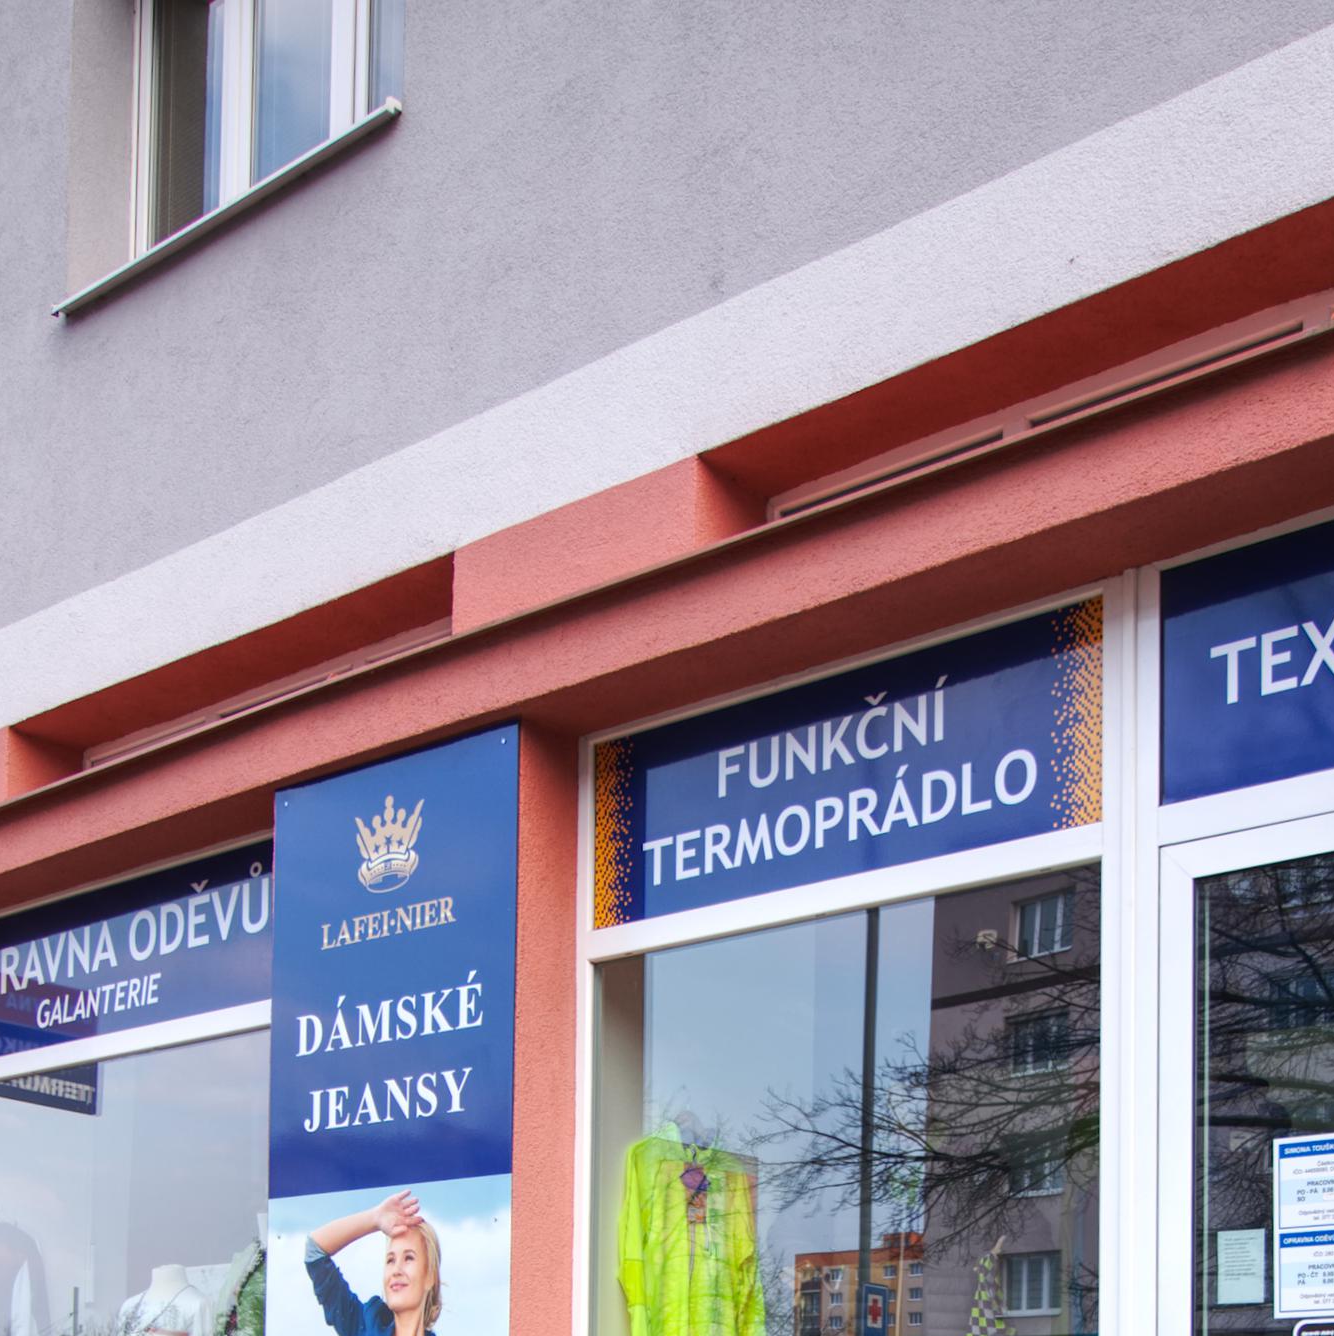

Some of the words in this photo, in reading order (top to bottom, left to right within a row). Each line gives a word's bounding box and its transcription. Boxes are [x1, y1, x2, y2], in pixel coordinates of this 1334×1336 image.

[716, 675, 948, 799] FUNKČNÍ
[642, 748, 1038, 887] TERMOPRÁDLO
[129, 862, 269, 961] ODĚVŮ
[36, 973, 161, 1029] GALANTERIE
[296, 969, 483, 1057] DÁMSKÉ
[303, 1067, 472, 1134] JEANSY
